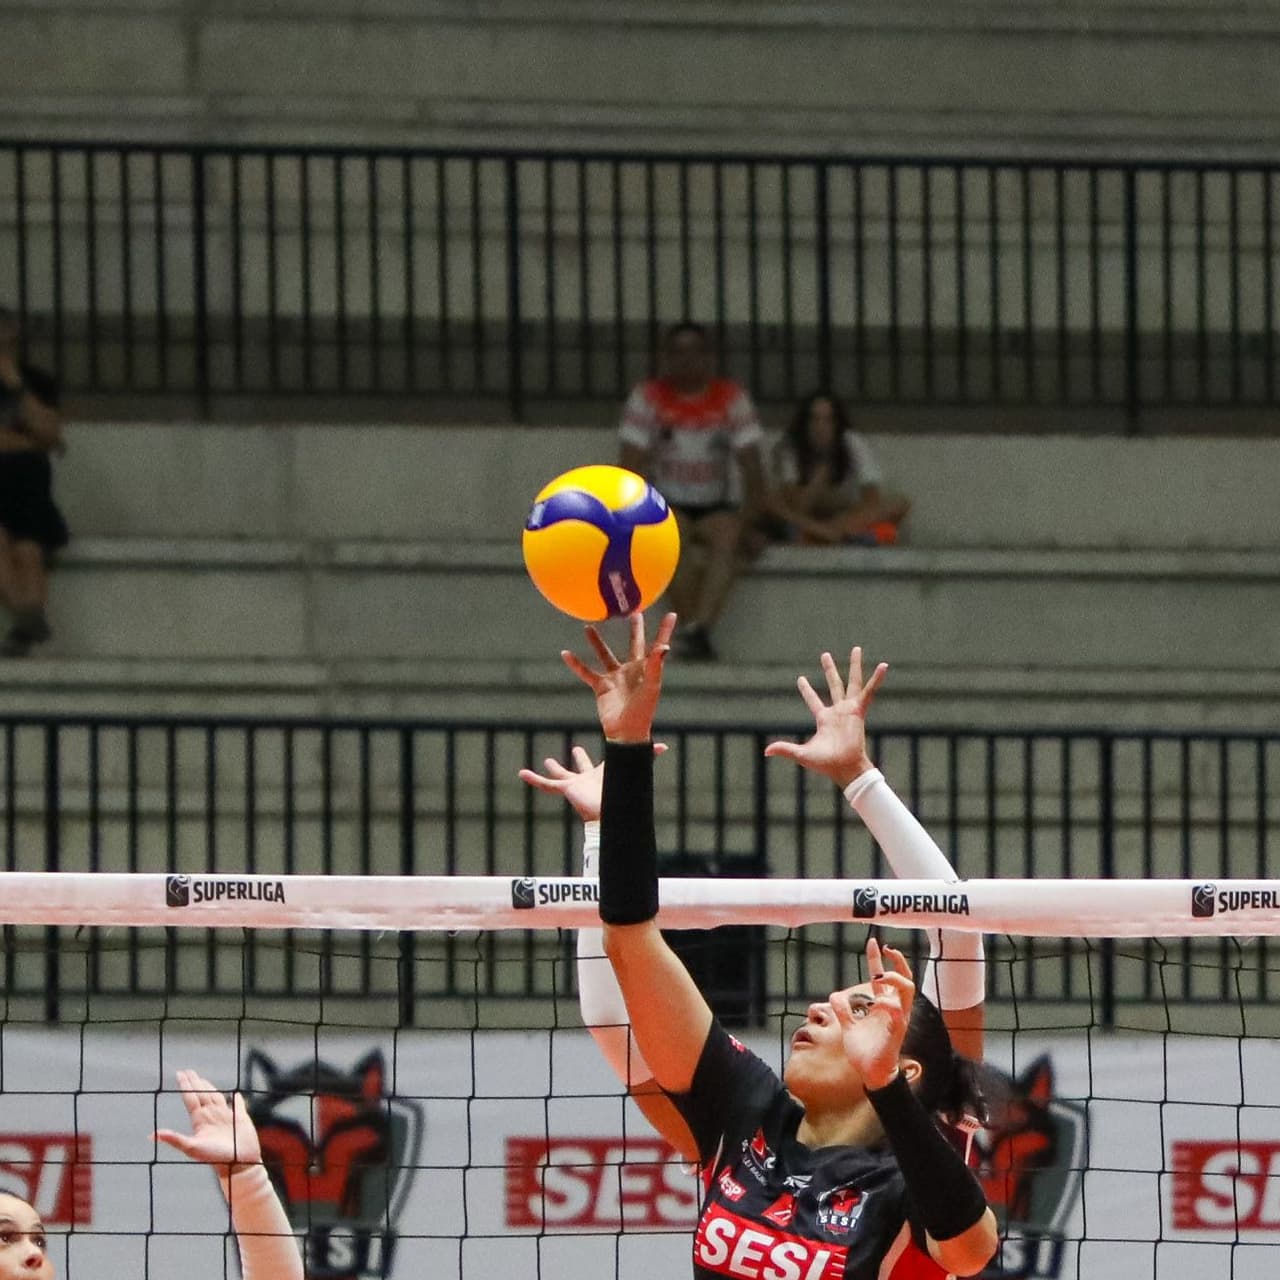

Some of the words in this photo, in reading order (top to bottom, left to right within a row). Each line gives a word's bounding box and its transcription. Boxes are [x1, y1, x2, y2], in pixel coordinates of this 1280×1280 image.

[193, 880, 286, 905] SUPERLIGA
[538, 882, 600, 905] SUPERL
[878, 893, 970, 916] SUPERLIGA
[528, 1147, 701, 1222] SES
[820, 1214, 858, 1228] SESI
